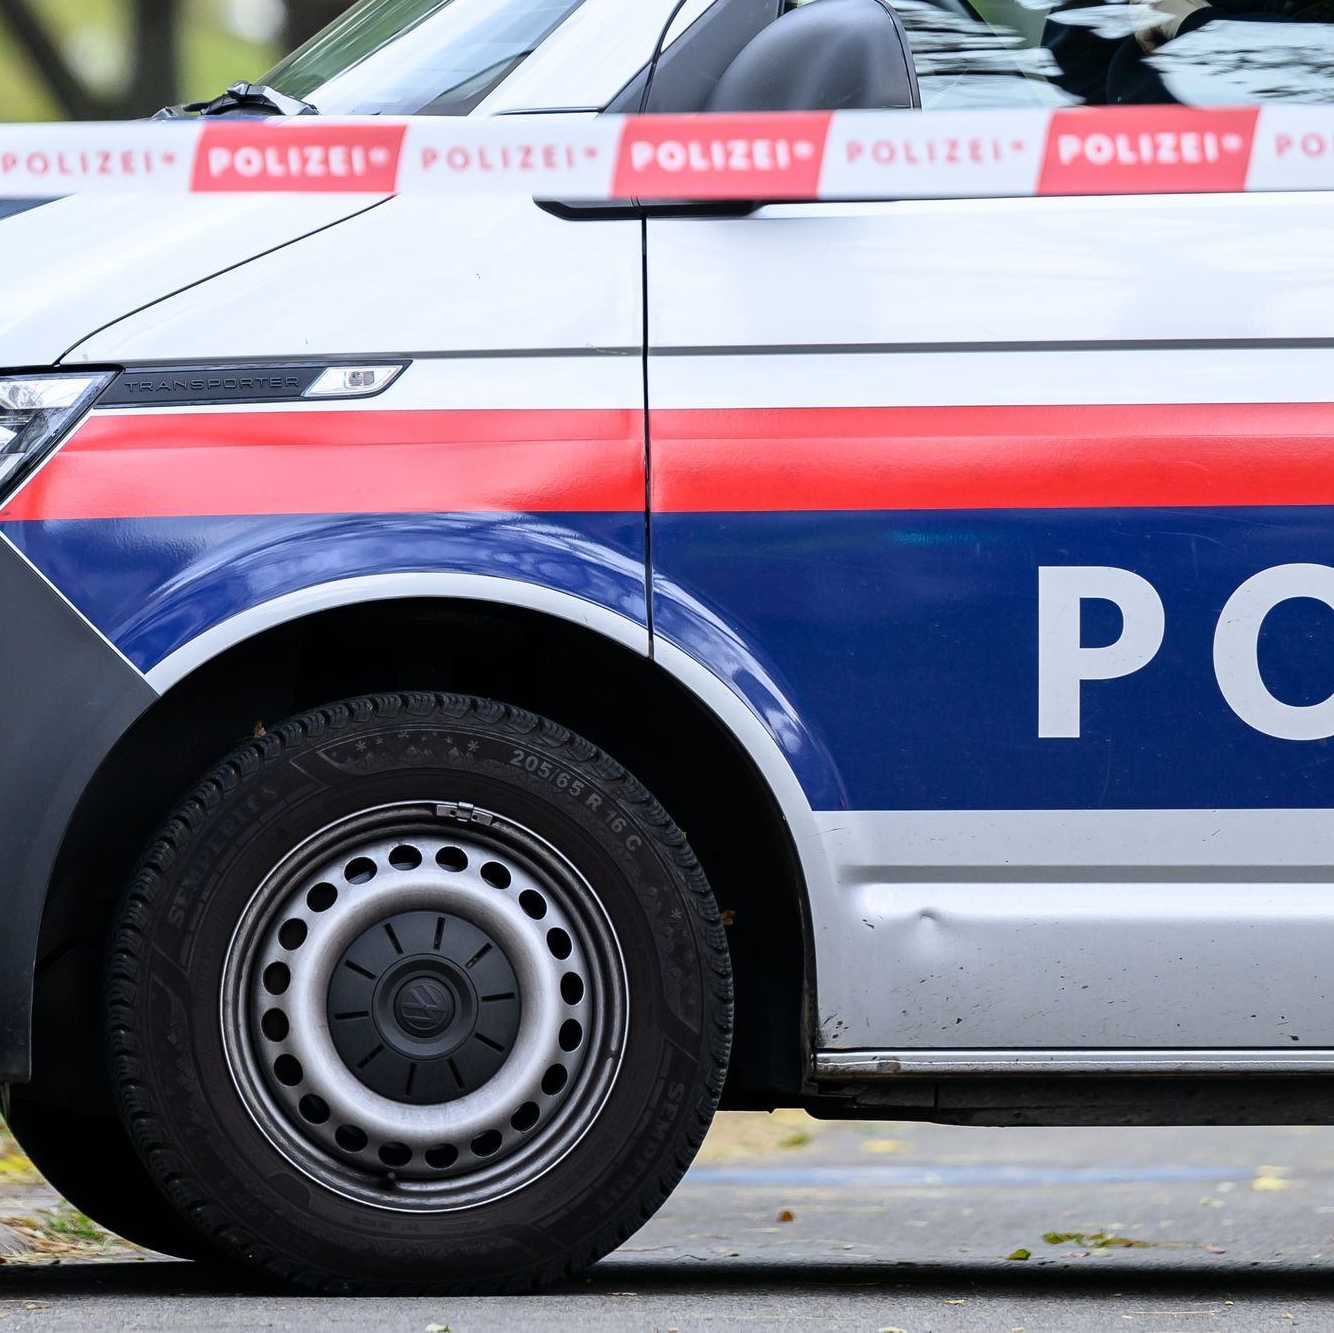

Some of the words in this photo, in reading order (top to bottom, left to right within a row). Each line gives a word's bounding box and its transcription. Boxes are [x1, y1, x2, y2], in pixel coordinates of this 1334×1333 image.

[2, 150, 153, 178] POLIZEI
[208, 144, 364, 179] POLIZEI
[421, 144, 575, 172] POLIZEI
[630, 138, 791, 171] POLIZEI
[846, 134, 1002, 166] POLIZEI
[1057, 130, 1218, 166] POLIZEI
[125, 376, 300, 393] TRANSPORTER
[510, 750, 585, 796] 205/65
[585, 793, 603, 812] R
[605, 810, 627, 833] 16
[626, 834, 642, 851] C
